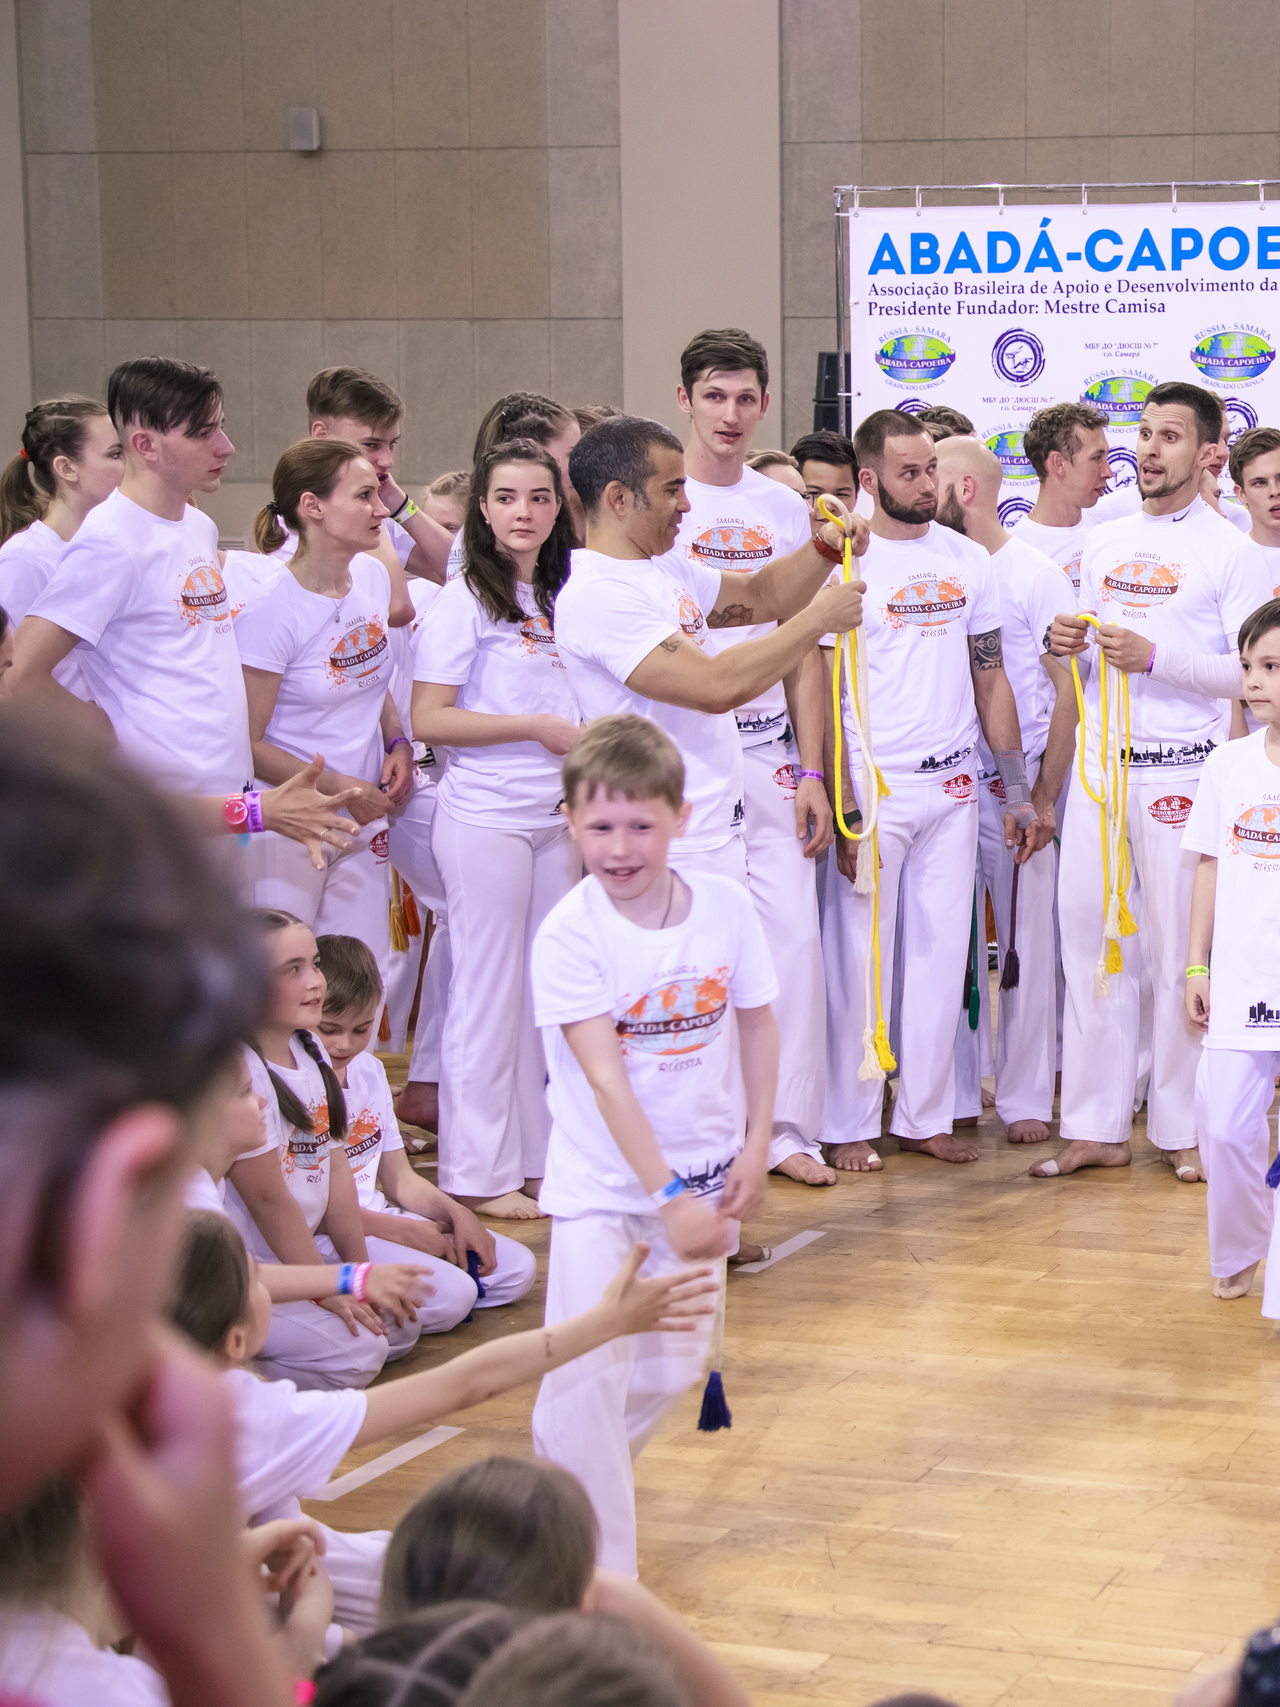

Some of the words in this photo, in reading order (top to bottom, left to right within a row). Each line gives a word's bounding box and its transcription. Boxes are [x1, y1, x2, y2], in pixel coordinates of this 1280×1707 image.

[868, 282, 949, 299] Associação
[954, 280, 1025, 296] Brasileira
[1030, 280, 1048, 294] de
[1053, 279, 1100, 298] Apoio
[1104, 283, 1112, 294] e
[1117, 277, 1255, 293] Desenvolvimento
[1259, 276, 1278, 292] da
[868, 301, 951, 316] Presidente
[957, 300, 1039, 315] Fundador:
[1044, 299, 1100, 315] Mestre
[1105, 298, 1166, 314] Camisa
[915, 325, 951, 344] SAMARA
[1233, 322, 1271, 341] SAMARA
[879, 357, 952, 368] ABADÁ-CAPOEIRA
[1194, 355, 1272, 366] ABADÁ-CAPOEIRA
[1122, 368, 1159, 386] SAMARA
[1201, 377, 1235, 389] GRADUADO
[1236, 377, 1265, 389] CURINGA
[885, 379, 918, 390] GRADUADO
[697, 547, 769, 559] ABADÁ-CAPOEIRA
[1106, 579, 1172, 594] ABADÁ-CAPOEIRA
[893, 600, 964, 613] ABADÁ-CAPOEIRA
